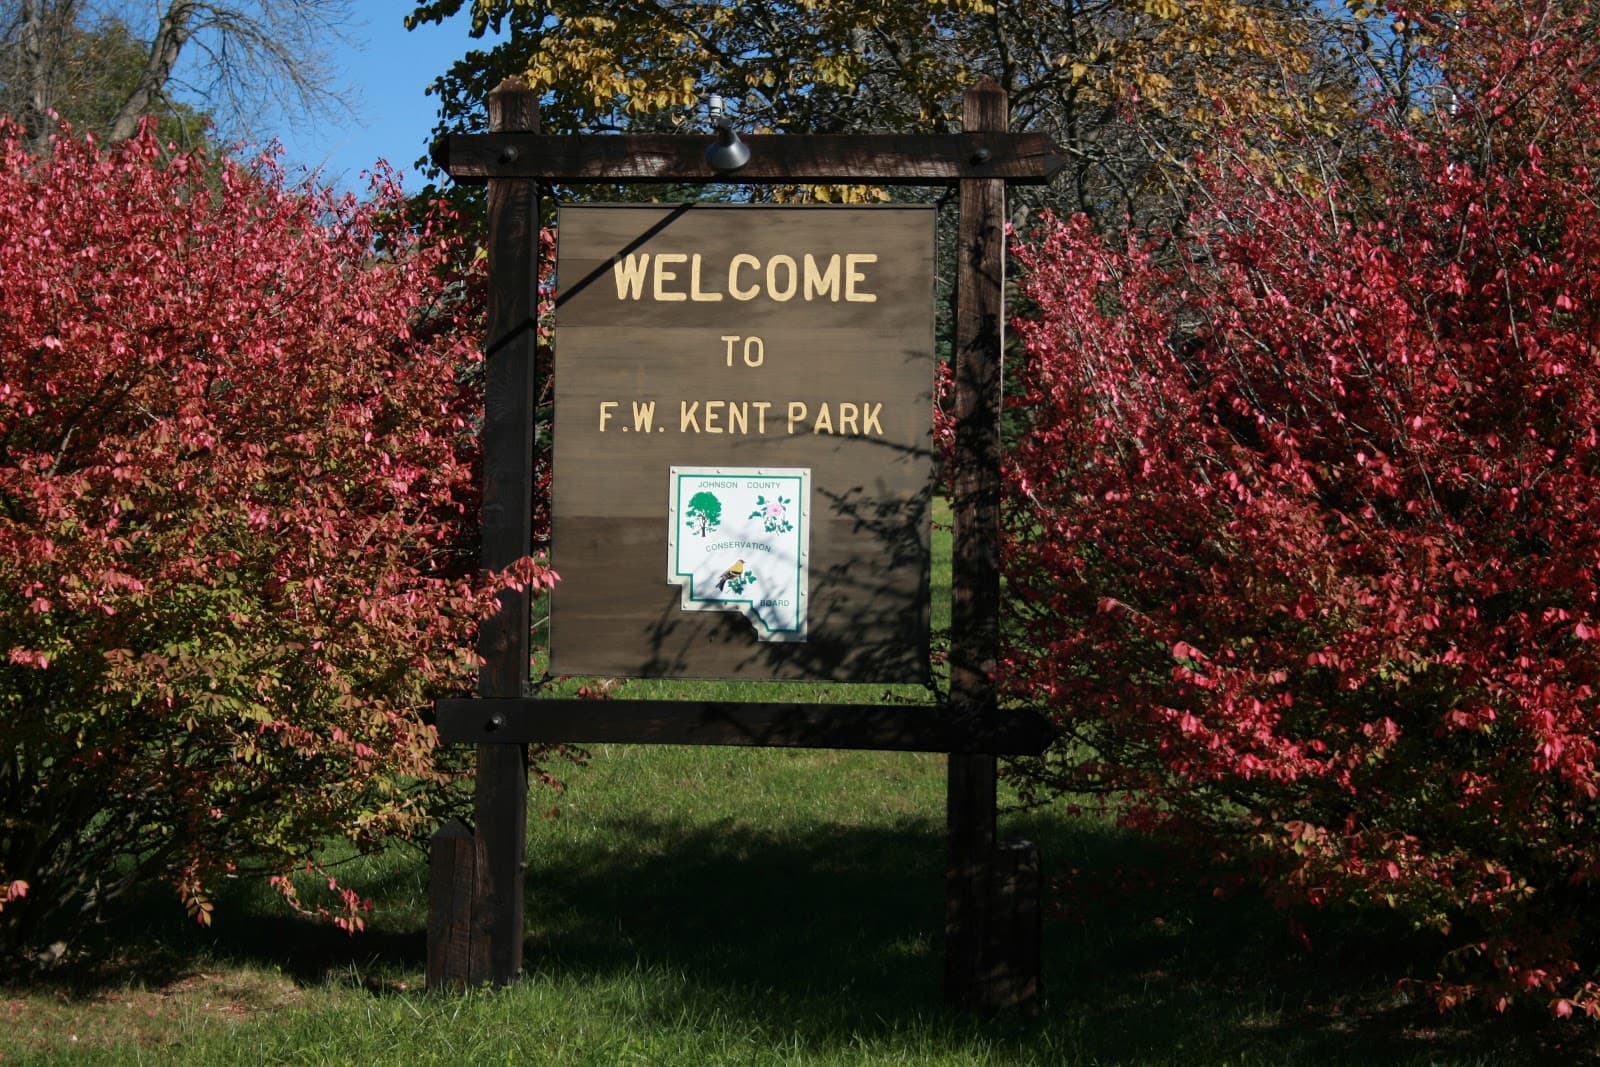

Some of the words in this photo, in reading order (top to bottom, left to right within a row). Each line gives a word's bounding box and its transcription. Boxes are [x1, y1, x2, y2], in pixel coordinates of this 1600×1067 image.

[613, 253, 878, 303] WELCOME
[721, 335, 764, 368] TO
[599, 401, 665, 433] F.W.
[680, 401, 771, 434] KENT
[787, 402, 884, 435] PARK
[698, 481, 738, 489] JOHNSON
[746, 481, 781, 489] COUNTY
[705, 541, 772, 553] CONSERVATION
[760, 599, 790, 607] BOARD
